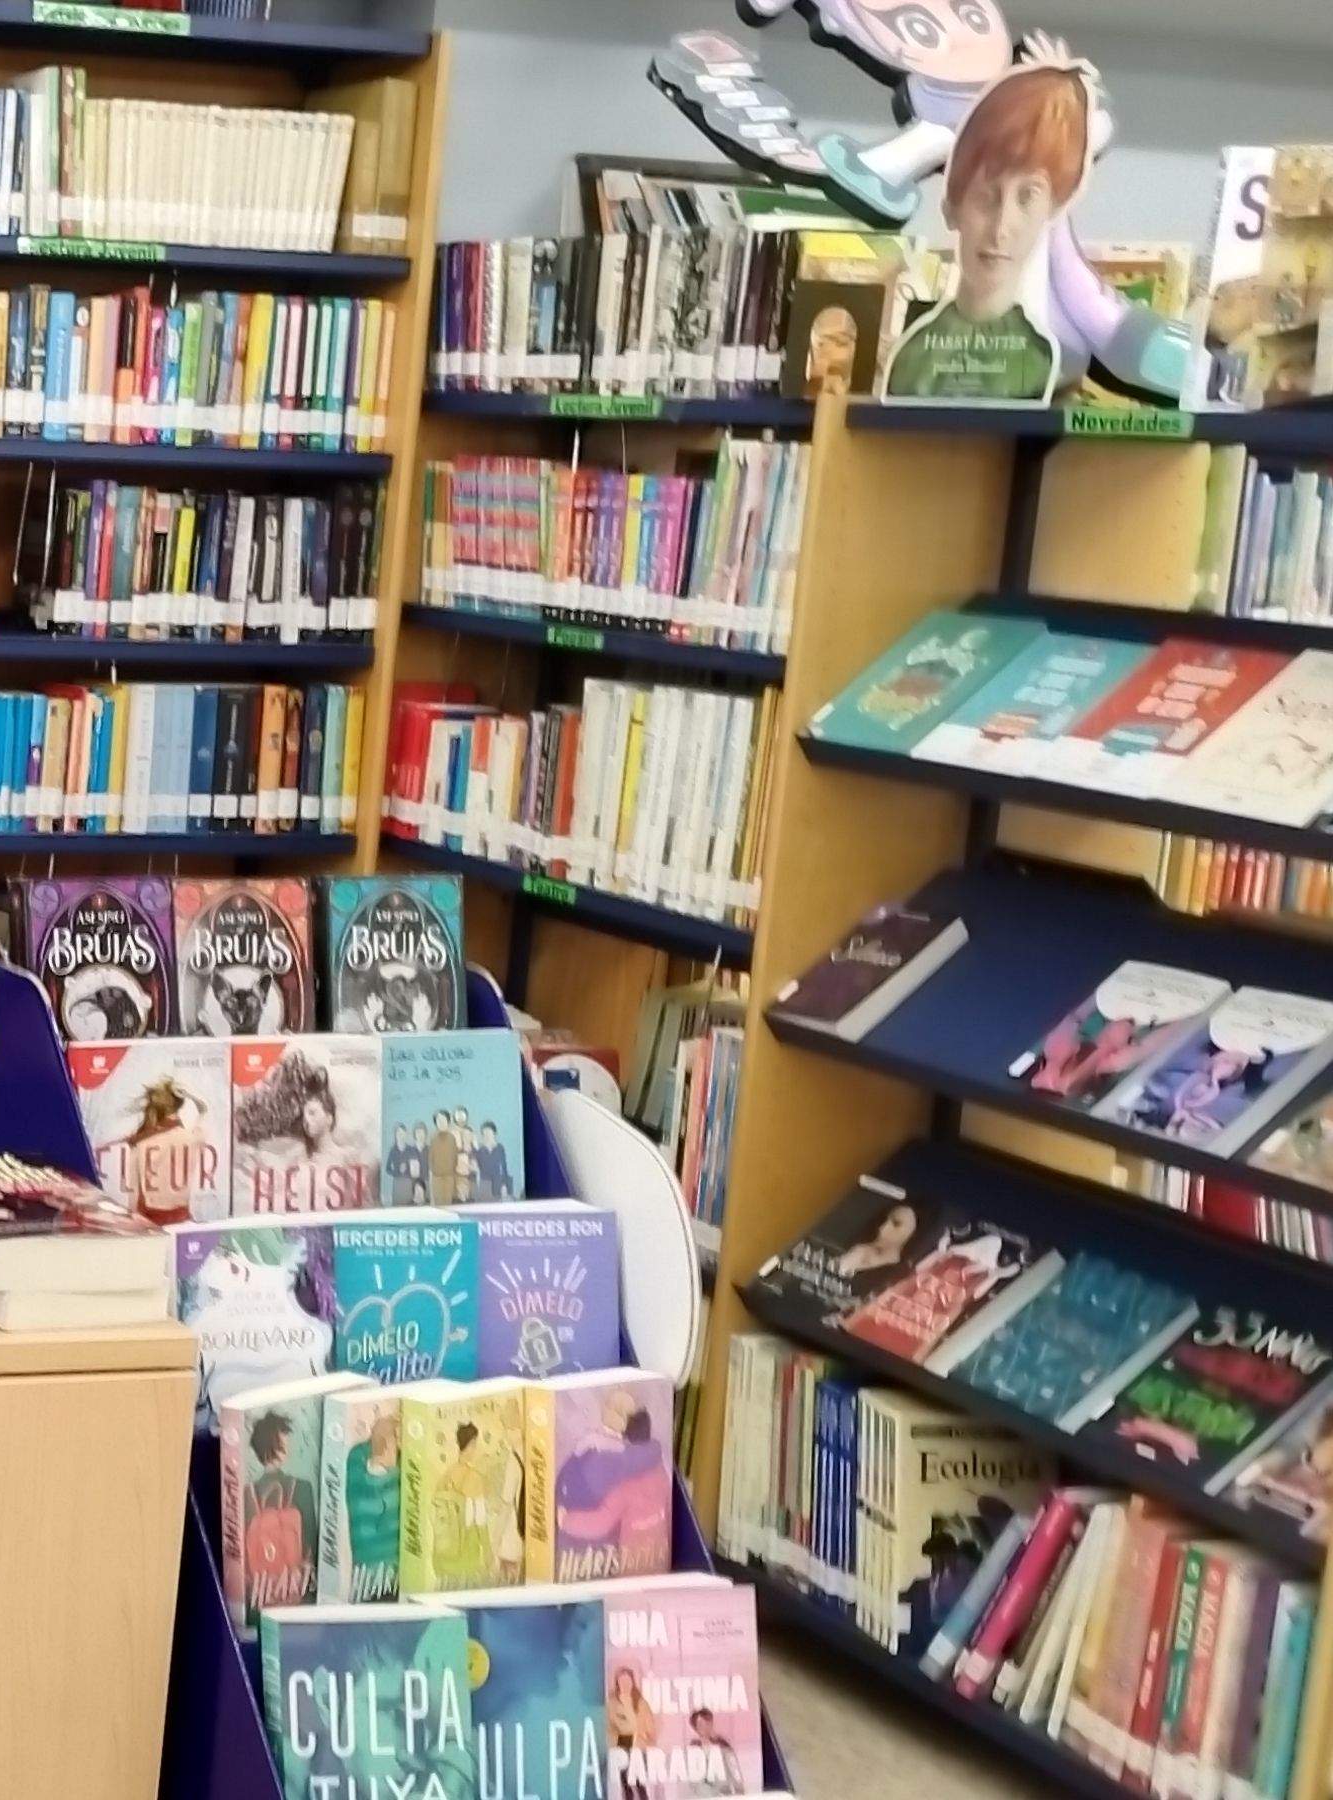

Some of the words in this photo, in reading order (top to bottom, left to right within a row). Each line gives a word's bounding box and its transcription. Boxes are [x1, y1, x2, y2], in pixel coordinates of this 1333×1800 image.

[924, 334, 969, 350] HARRY
[974, 334, 1027, 351] POTTER
[1071, 411, 1181, 433] Novedades
[48, 924, 157, 976] BRUJAS
[189, 927, 294, 976] BRUJAS
[346, 922, 448, 973] BRUJAS
[96, 1143, 219, 1193] FLEUR
[253, 1163, 369, 1214] HEIST
[423, 1226, 463, 1247] RON
[478, 1219, 567, 1238] MERCEDES
[569, 1220, 604, 1237] RON
[200, 1326, 316, 1353] BOULEVARD
[608, 1609, 670, 1648] UNA
[288, 1667, 466, 1760] CULPA
[477, 1716, 603, 1800] ULPA
[607, 1742, 727, 1790] PARADA
